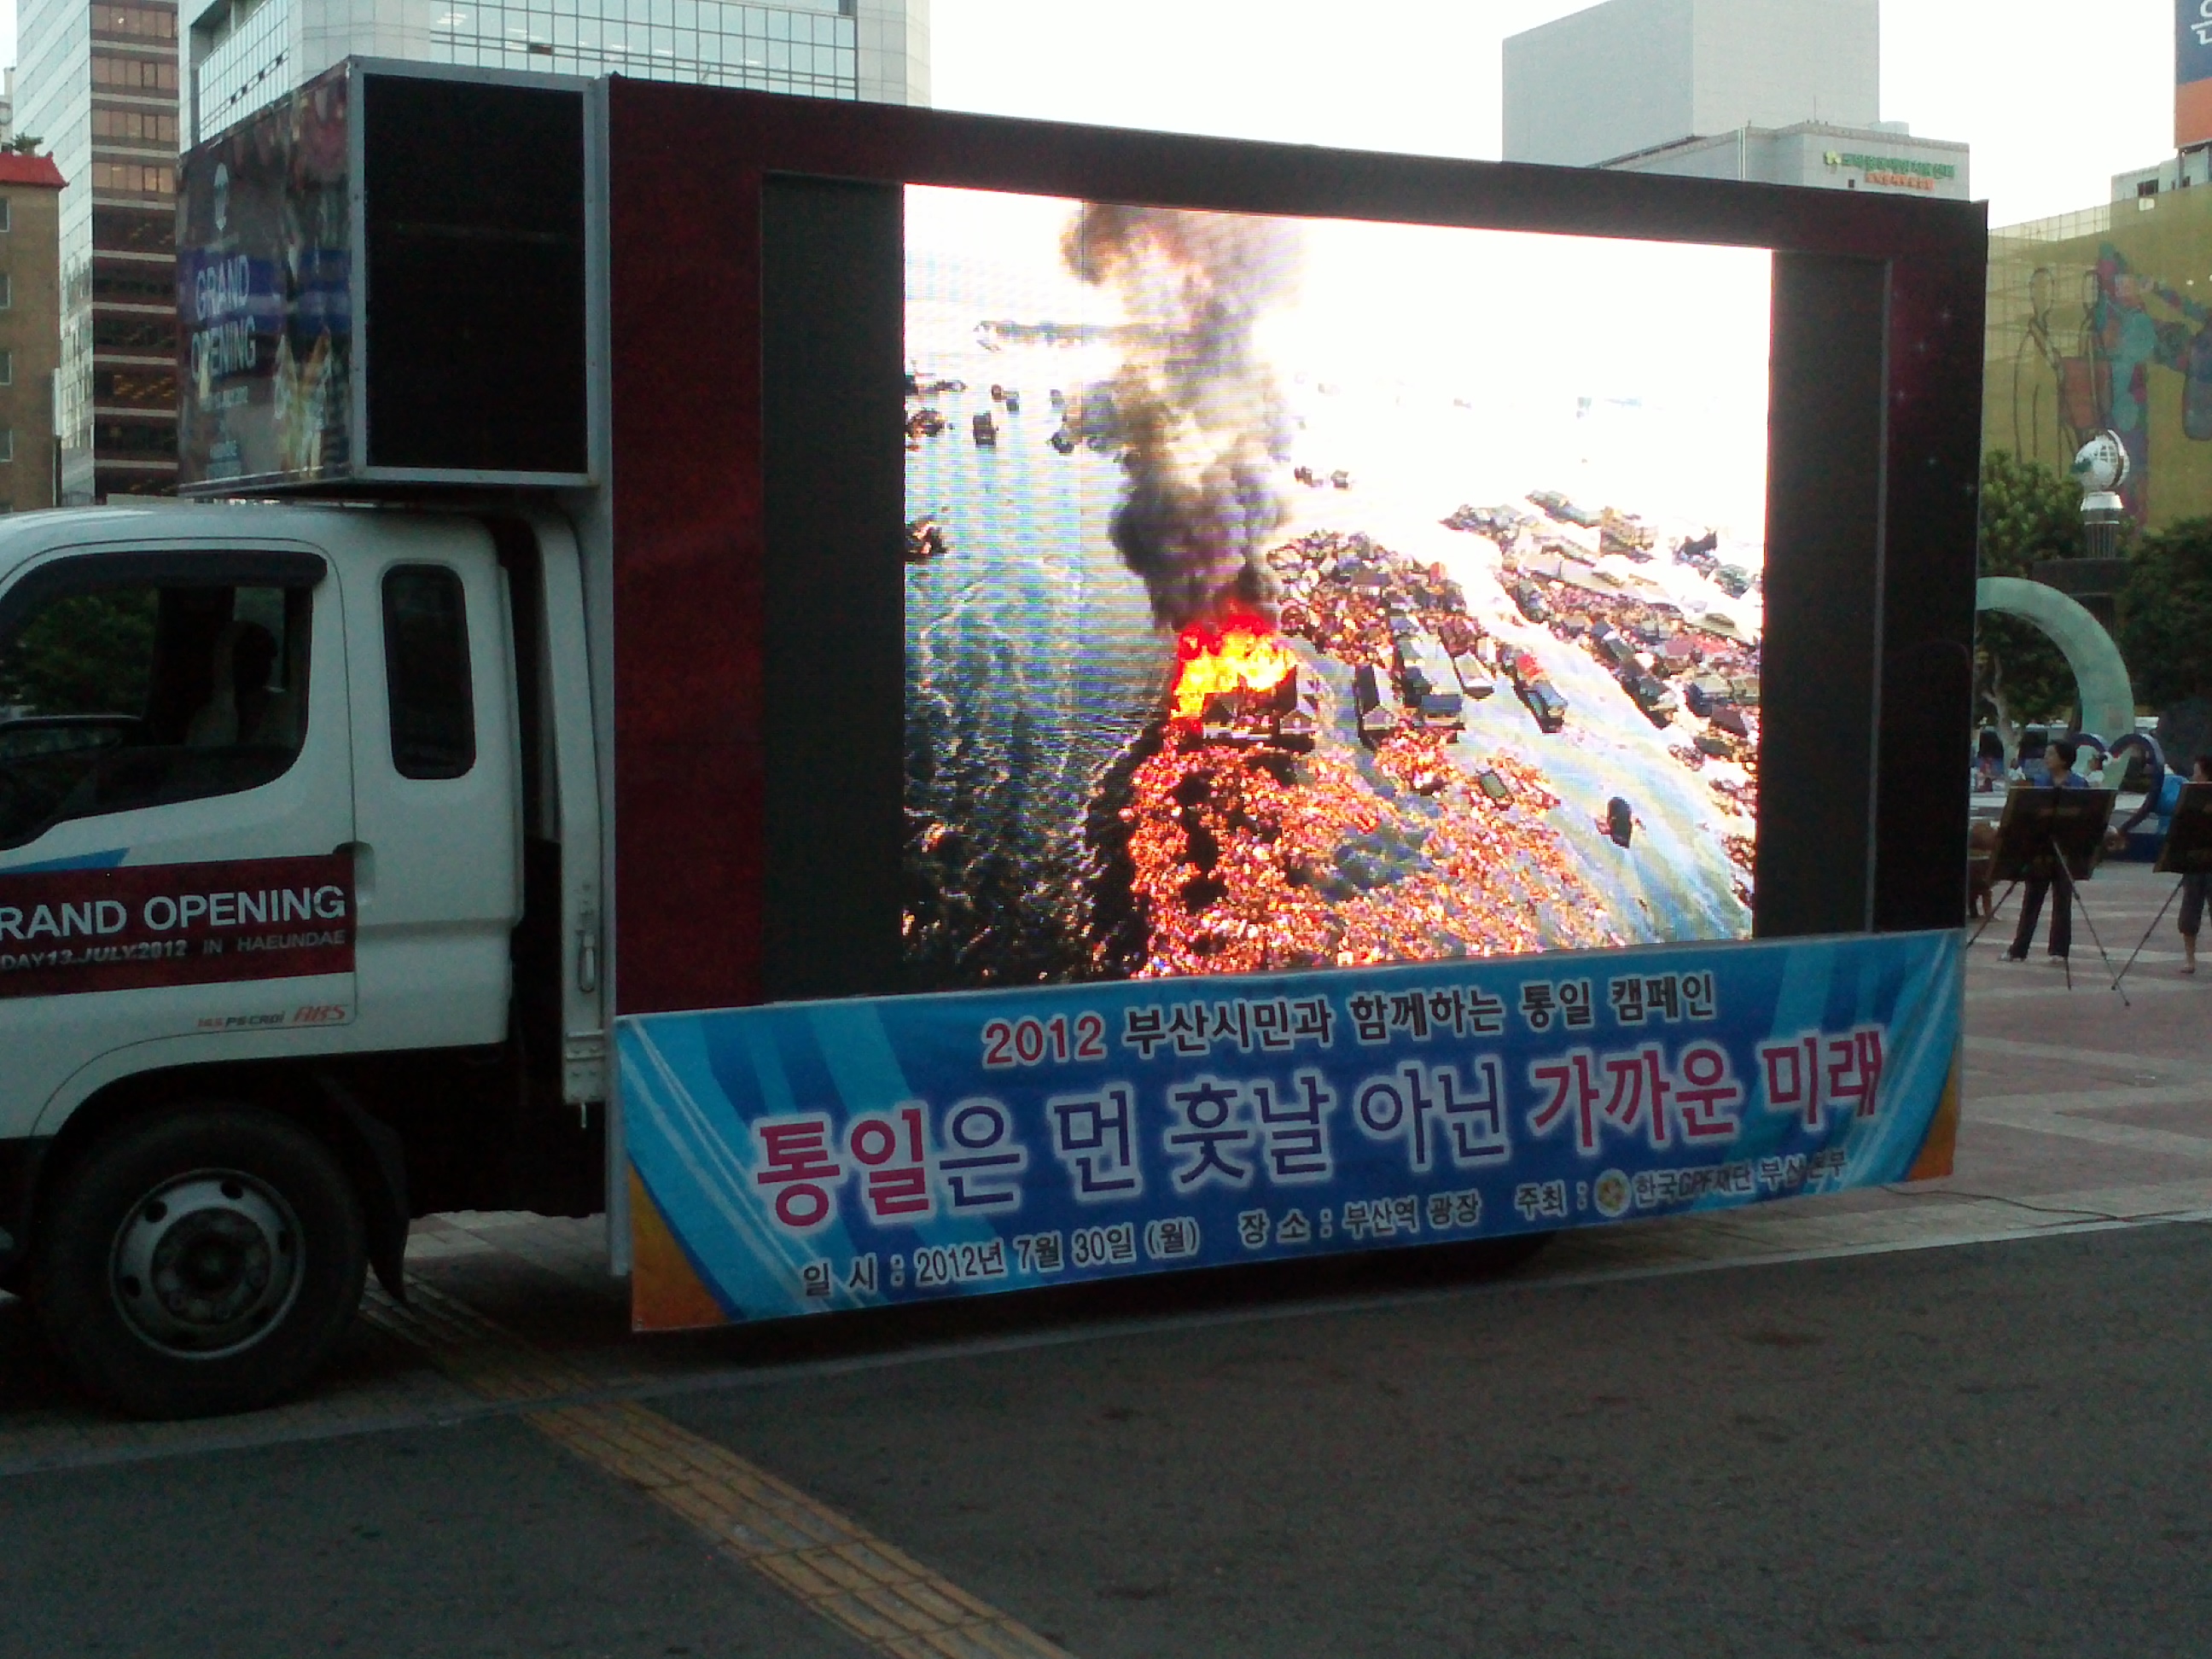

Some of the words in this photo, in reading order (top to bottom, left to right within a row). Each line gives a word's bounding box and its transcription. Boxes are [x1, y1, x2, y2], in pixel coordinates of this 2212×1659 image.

[196, 255, 250, 319] GRAND
[191, 315, 255, 383] OPENING
[143, 884, 346, 932] OPENING
[203, 939, 223, 953] IN
[238, 929, 346, 952] HAEUNDAE
[985, 1017, 1103, 1064] 2012
[1126, 998, 1331, 1054] 부산시민과
[1350, 989, 1503, 1040] 함께하는
[1522, 982, 1589, 1027] 통일
[1611, 974, 1713, 1021] 캠페인
[757, 1104, 1021, 1227] 통일은
[1054, 1090, 1135, 1192] 먼
[1171, 1076, 1330, 1184] 훗날
[1359, 1062, 1505, 1166] 아닌
[1534, 1048, 1738, 1148] 가까운
[1761, 1031, 1883, 1126] 미래
[917, 1242, 1004, 1282] 2012년
[1019, 1234, 1060, 1268] 7월
[1073, 1228, 1133, 1263] 30일
[1145, 1222, 1197, 1254] (월)
[1346, 1200, 1417, 1234] 부산역
[1429, 1194, 1479, 1226] 광장
[1517, 1183, 1565, 1217] 주최
